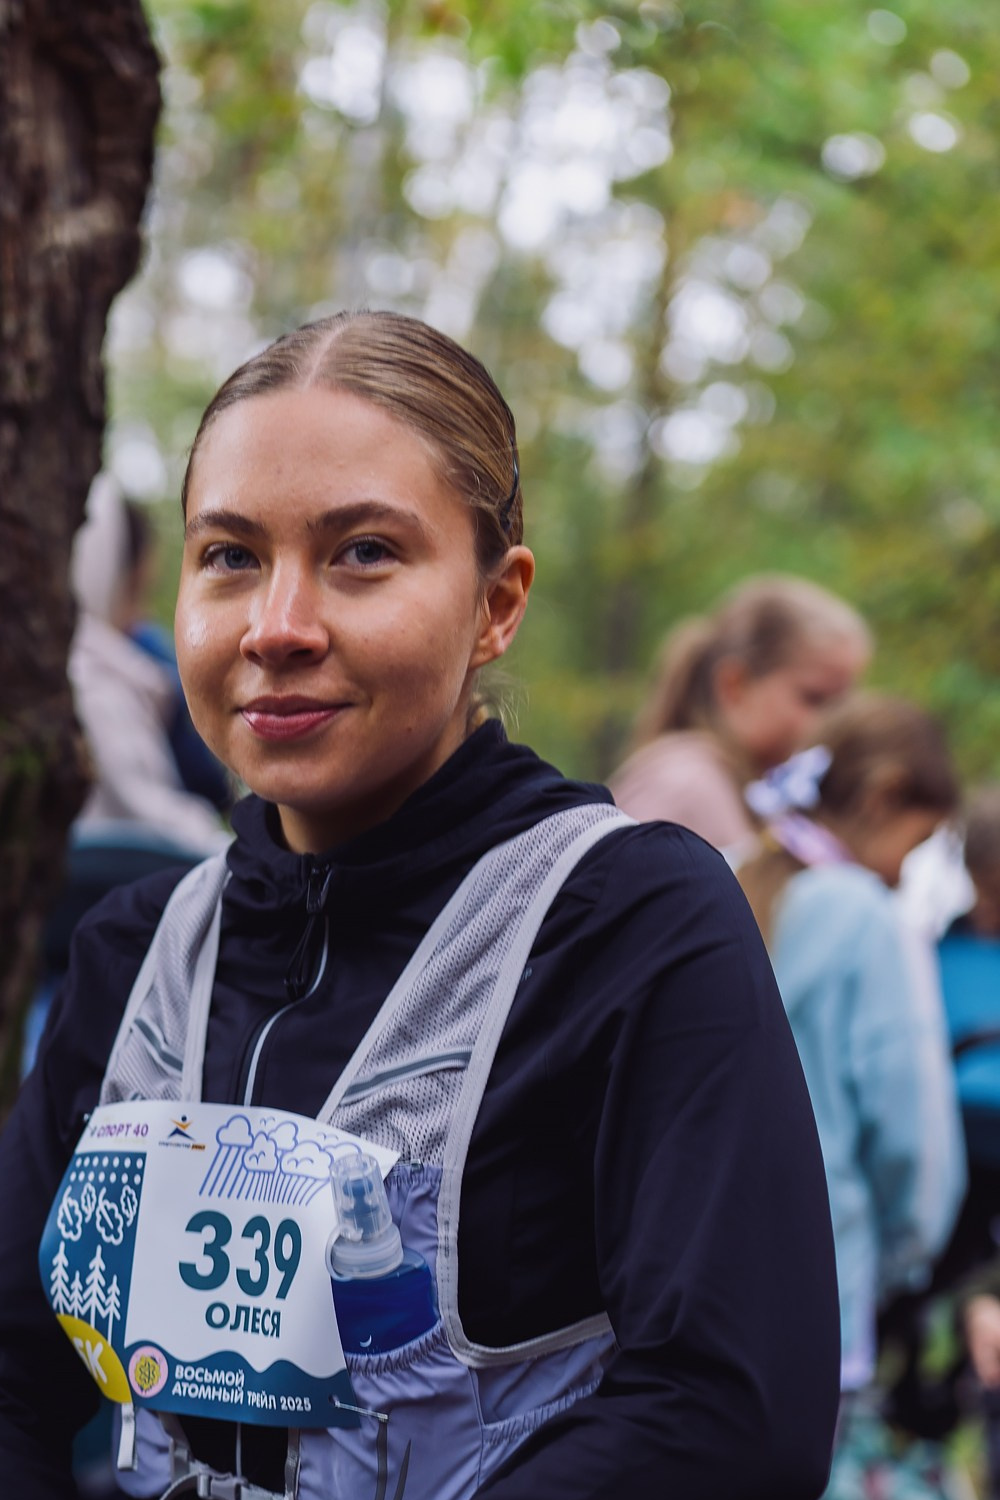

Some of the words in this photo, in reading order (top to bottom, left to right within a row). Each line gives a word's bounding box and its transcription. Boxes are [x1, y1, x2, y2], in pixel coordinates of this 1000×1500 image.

[133, 1123, 150, 1137] 40
[178, 1210, 303, 1300] 339
[205, 1302, 282, 1339] ОЛЕСЯ
[175, 1364, 245, 1388] ВОСЬМОЙ
[172, 1381, 244, 1405] АТОМНЫЙ
[247, 1389, 277, 1410] ТРЕЙЛ
[280, 1395, 312, 1412] 2025
